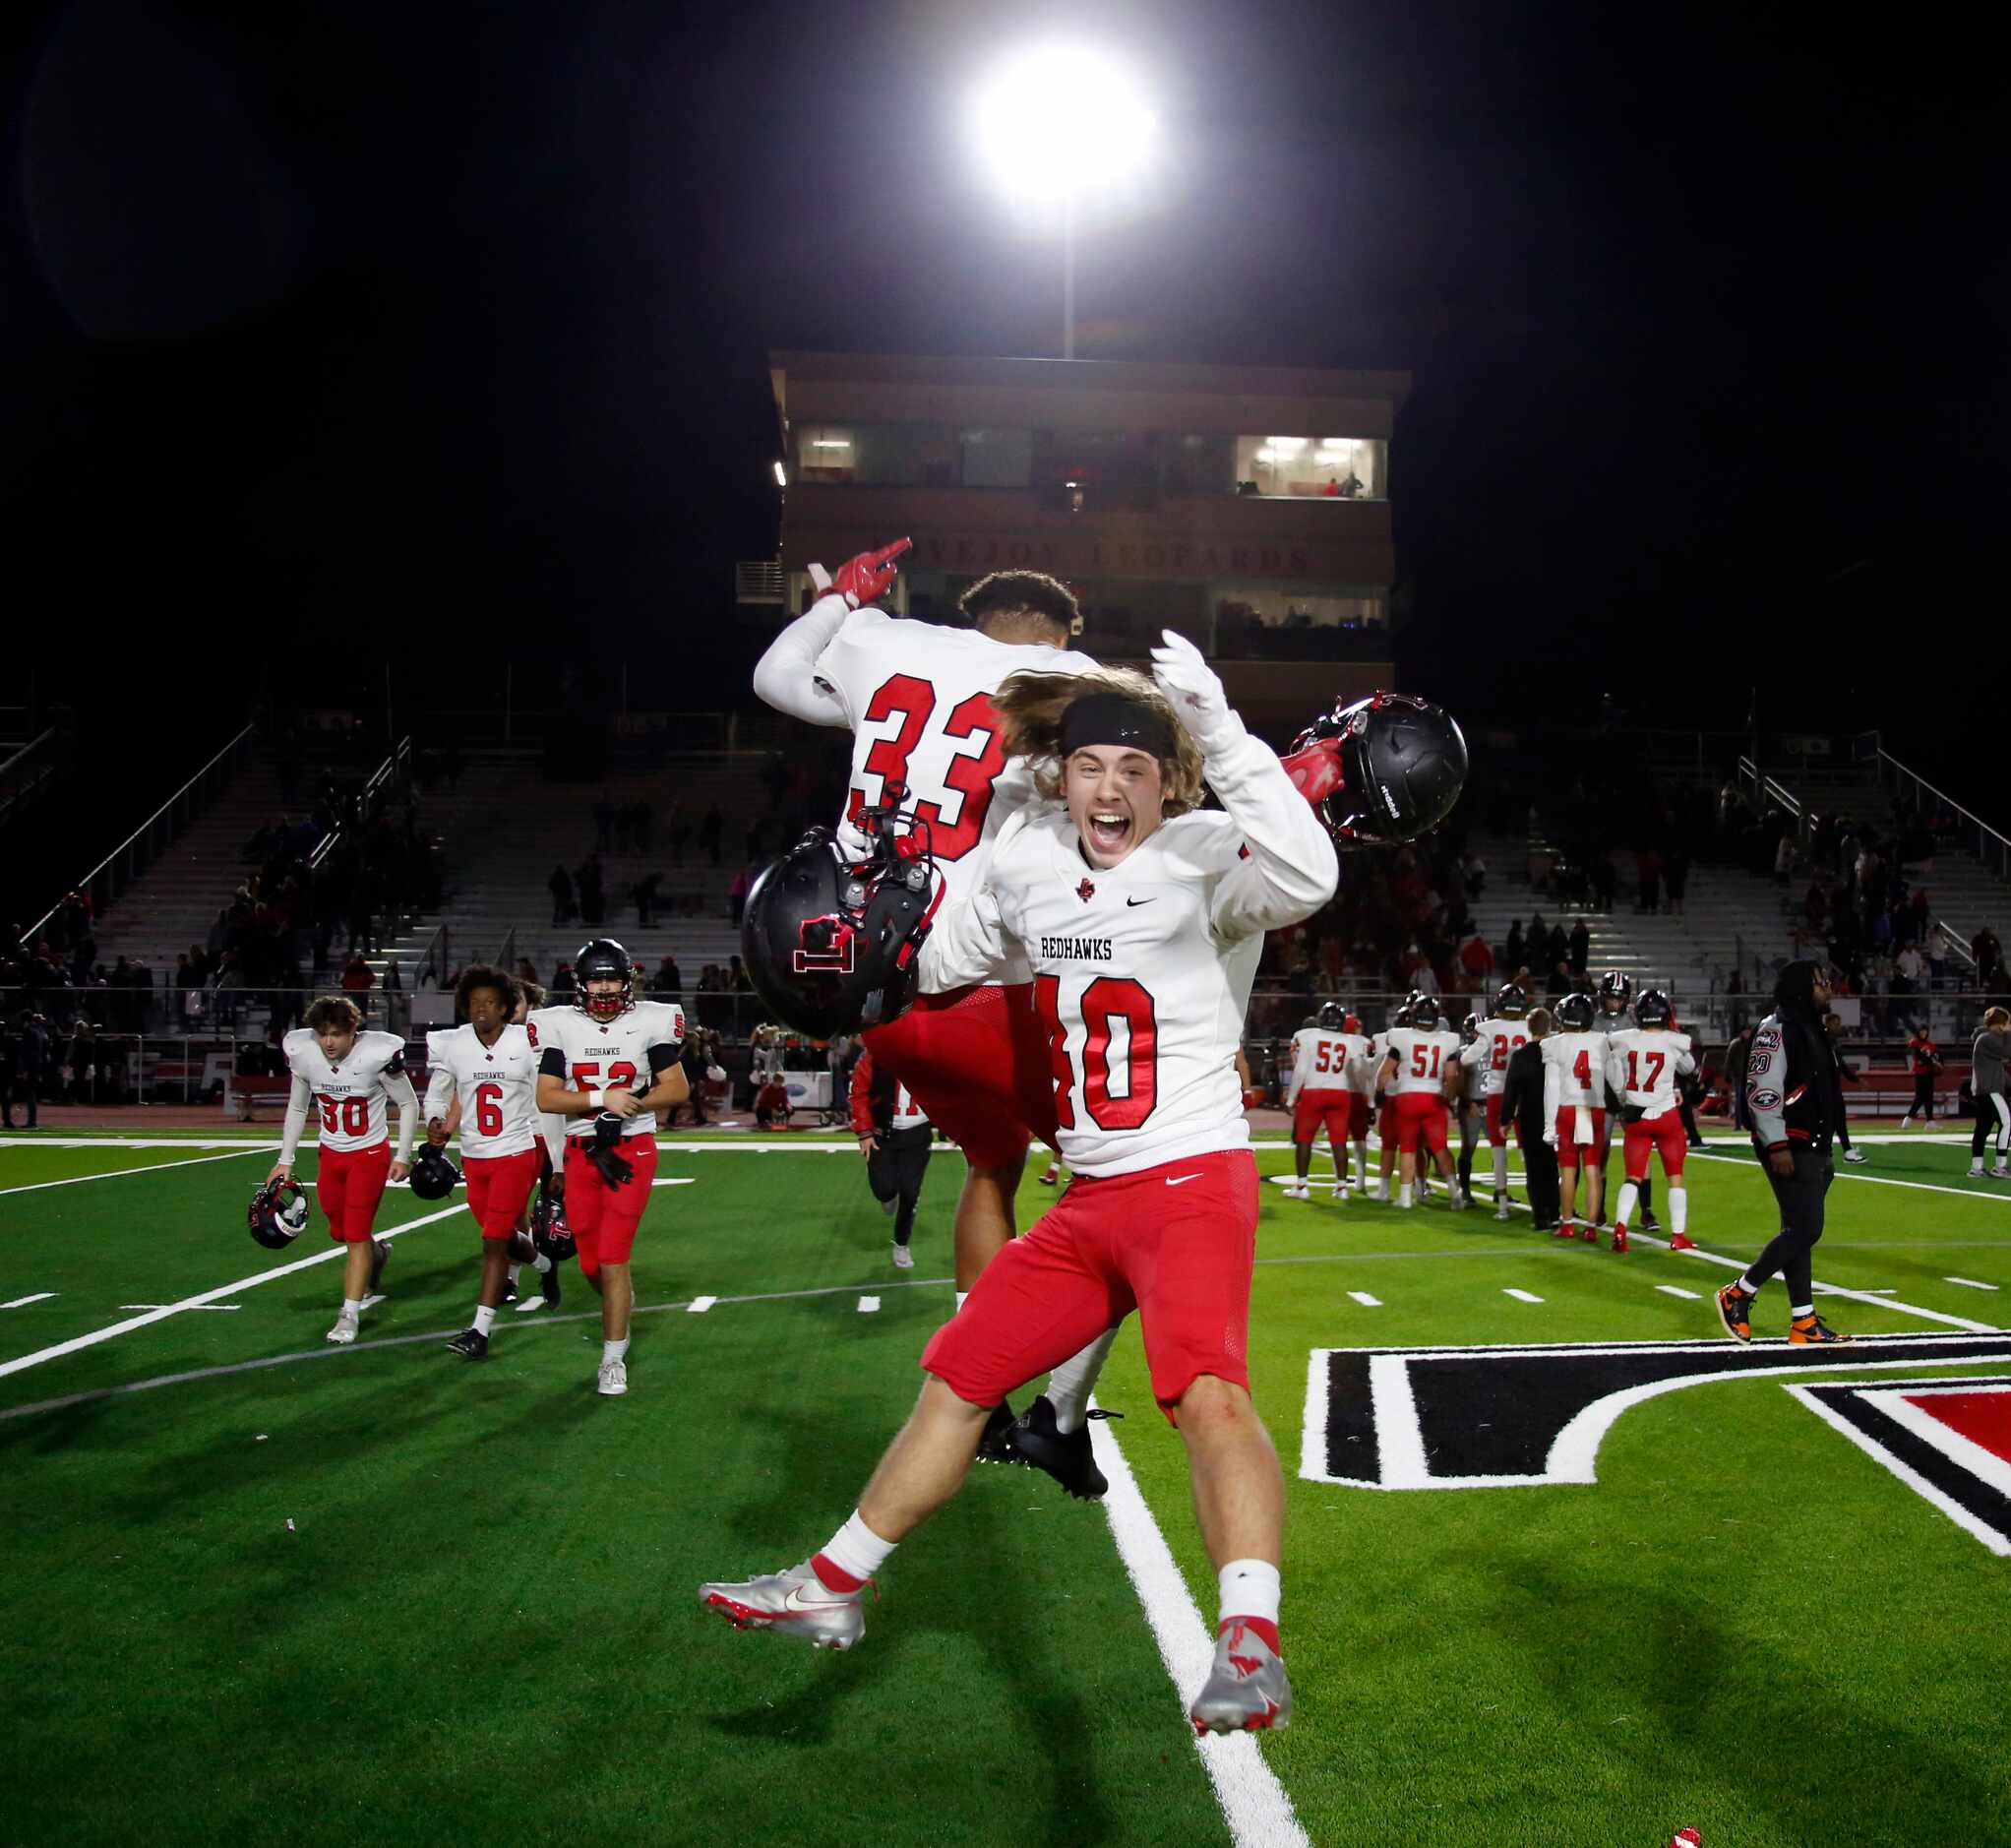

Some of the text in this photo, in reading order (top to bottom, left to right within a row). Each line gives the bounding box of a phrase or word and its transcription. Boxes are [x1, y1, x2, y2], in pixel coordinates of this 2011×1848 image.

[890, 538, 1055, 564] OVEJOY
[847, 673, 1006, 862] 33
[1041, 937, 1113, 960] REDHAWKS
[1315, 1041, 1347, 1074] 53
[1410, 1044, 1440, 1078] 51
[1574, 1050, 1591, 1089] 4
[1626, 1050, 1665, 1092] 17
[476, 1082, 503, 1137] 6
[572, 1061, 637, 1119] 52
[316, 1093, 369, 1137] 30
